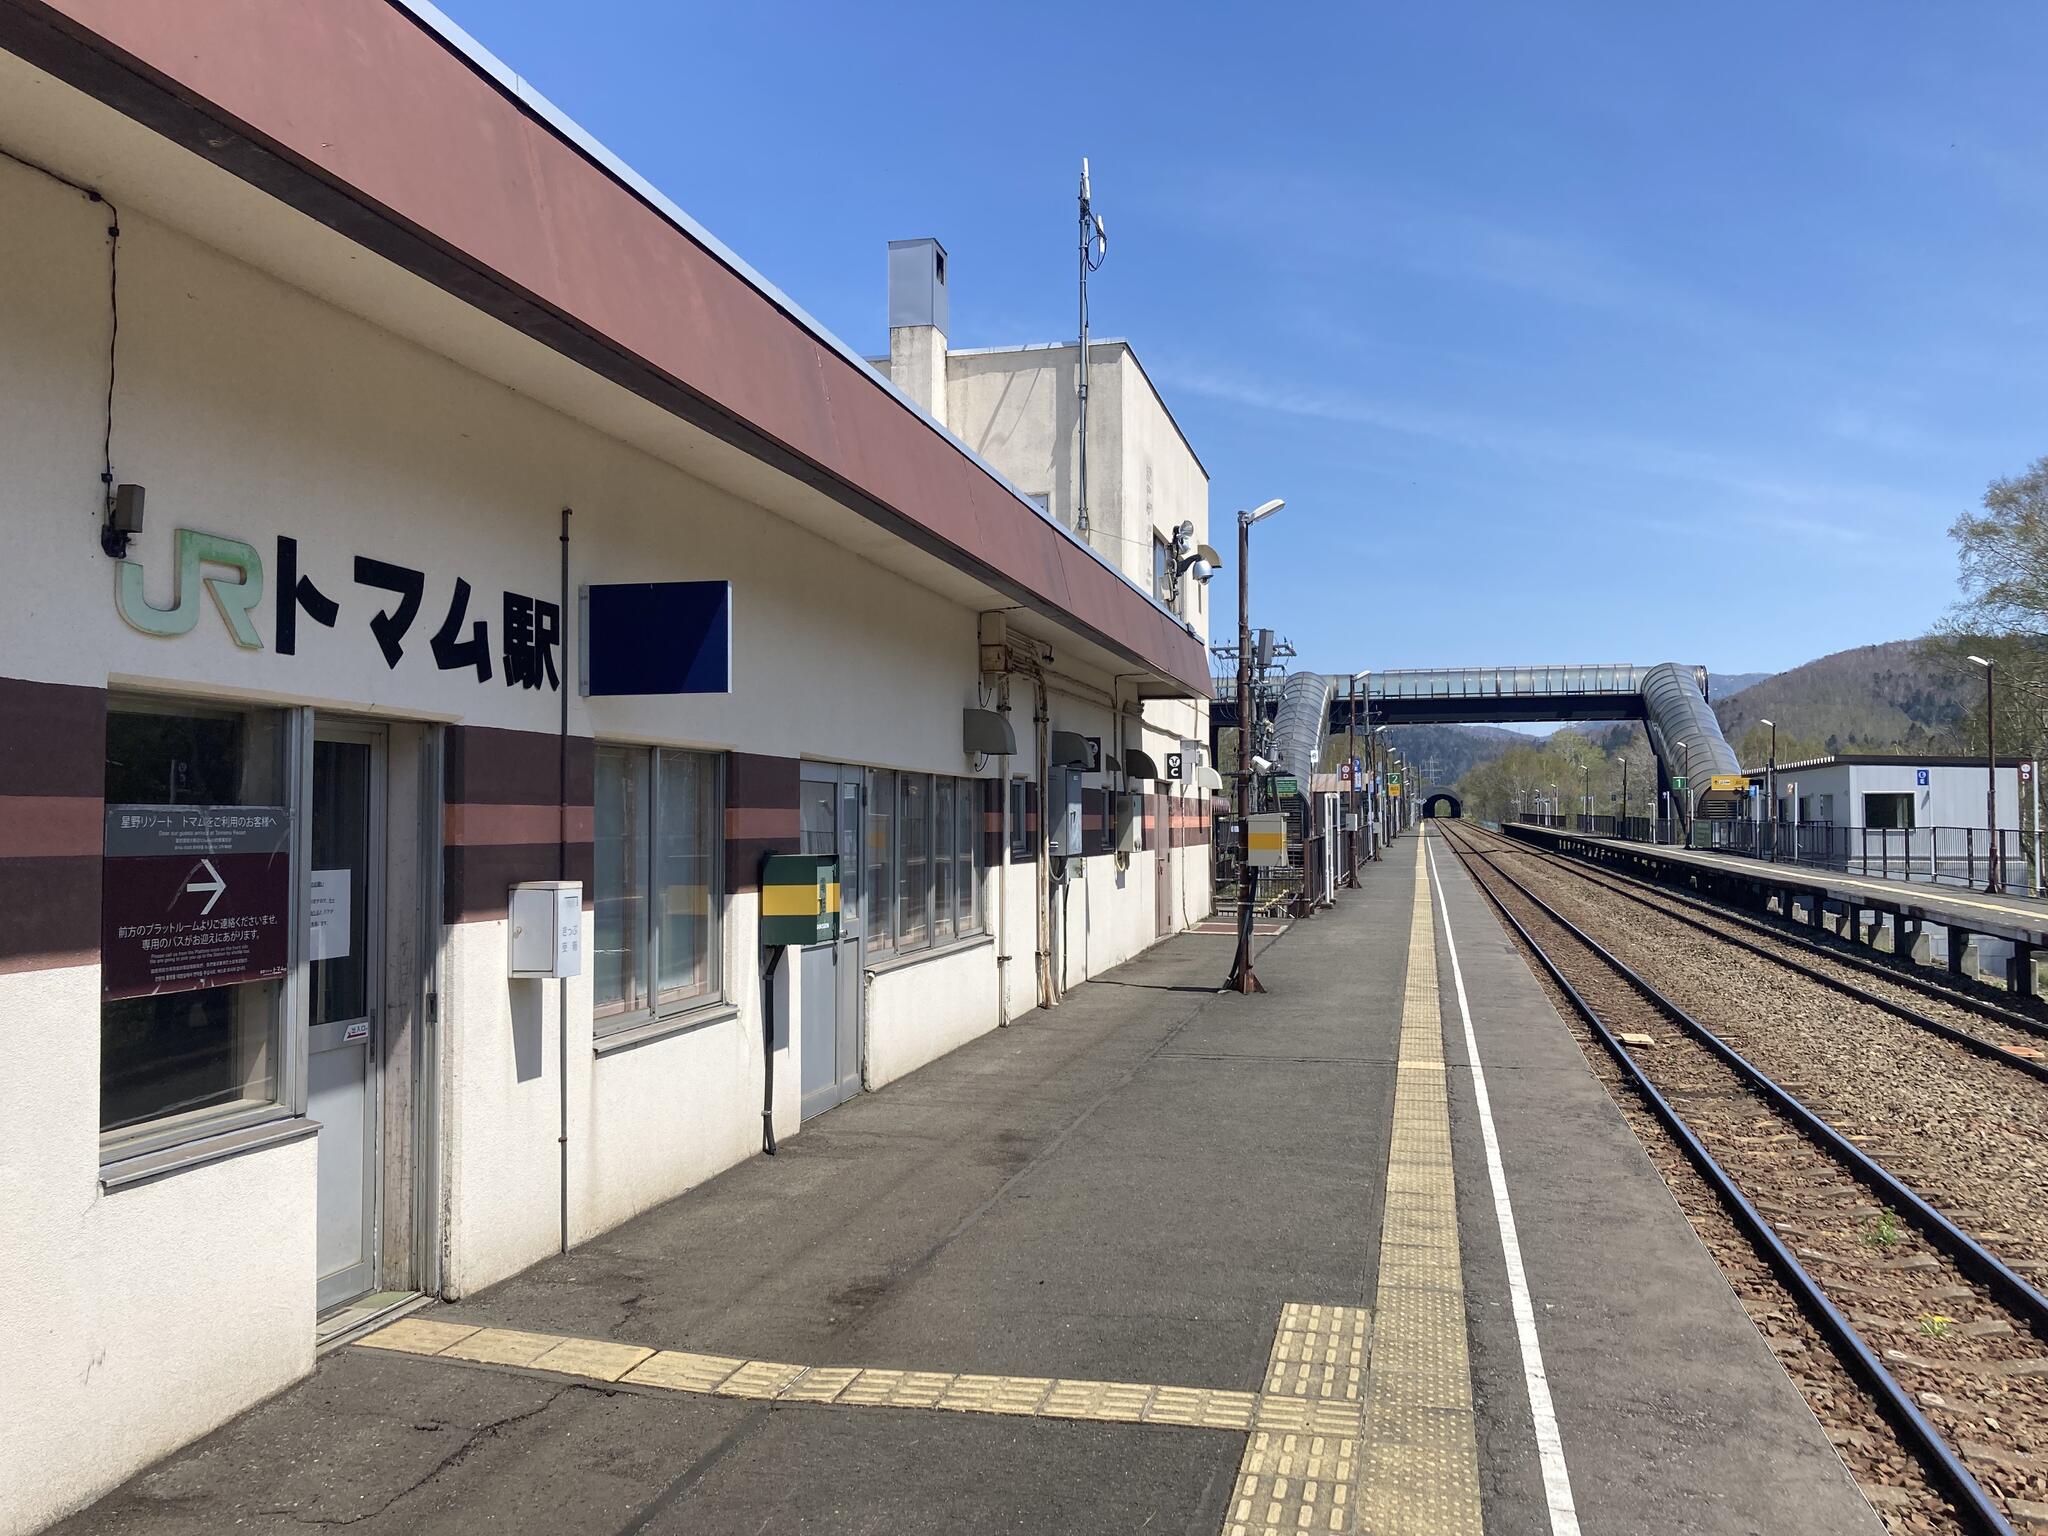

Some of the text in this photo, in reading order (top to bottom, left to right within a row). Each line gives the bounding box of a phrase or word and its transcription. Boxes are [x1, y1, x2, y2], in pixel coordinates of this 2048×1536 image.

[114, 528, 265, 650] JR
[275, 535, 561, 692] トマム駅
[1170, 768, 1179, 777] C
[1392, 775, 1398, 784] 2
[120, 815, 173, 829] 星野リゾート
